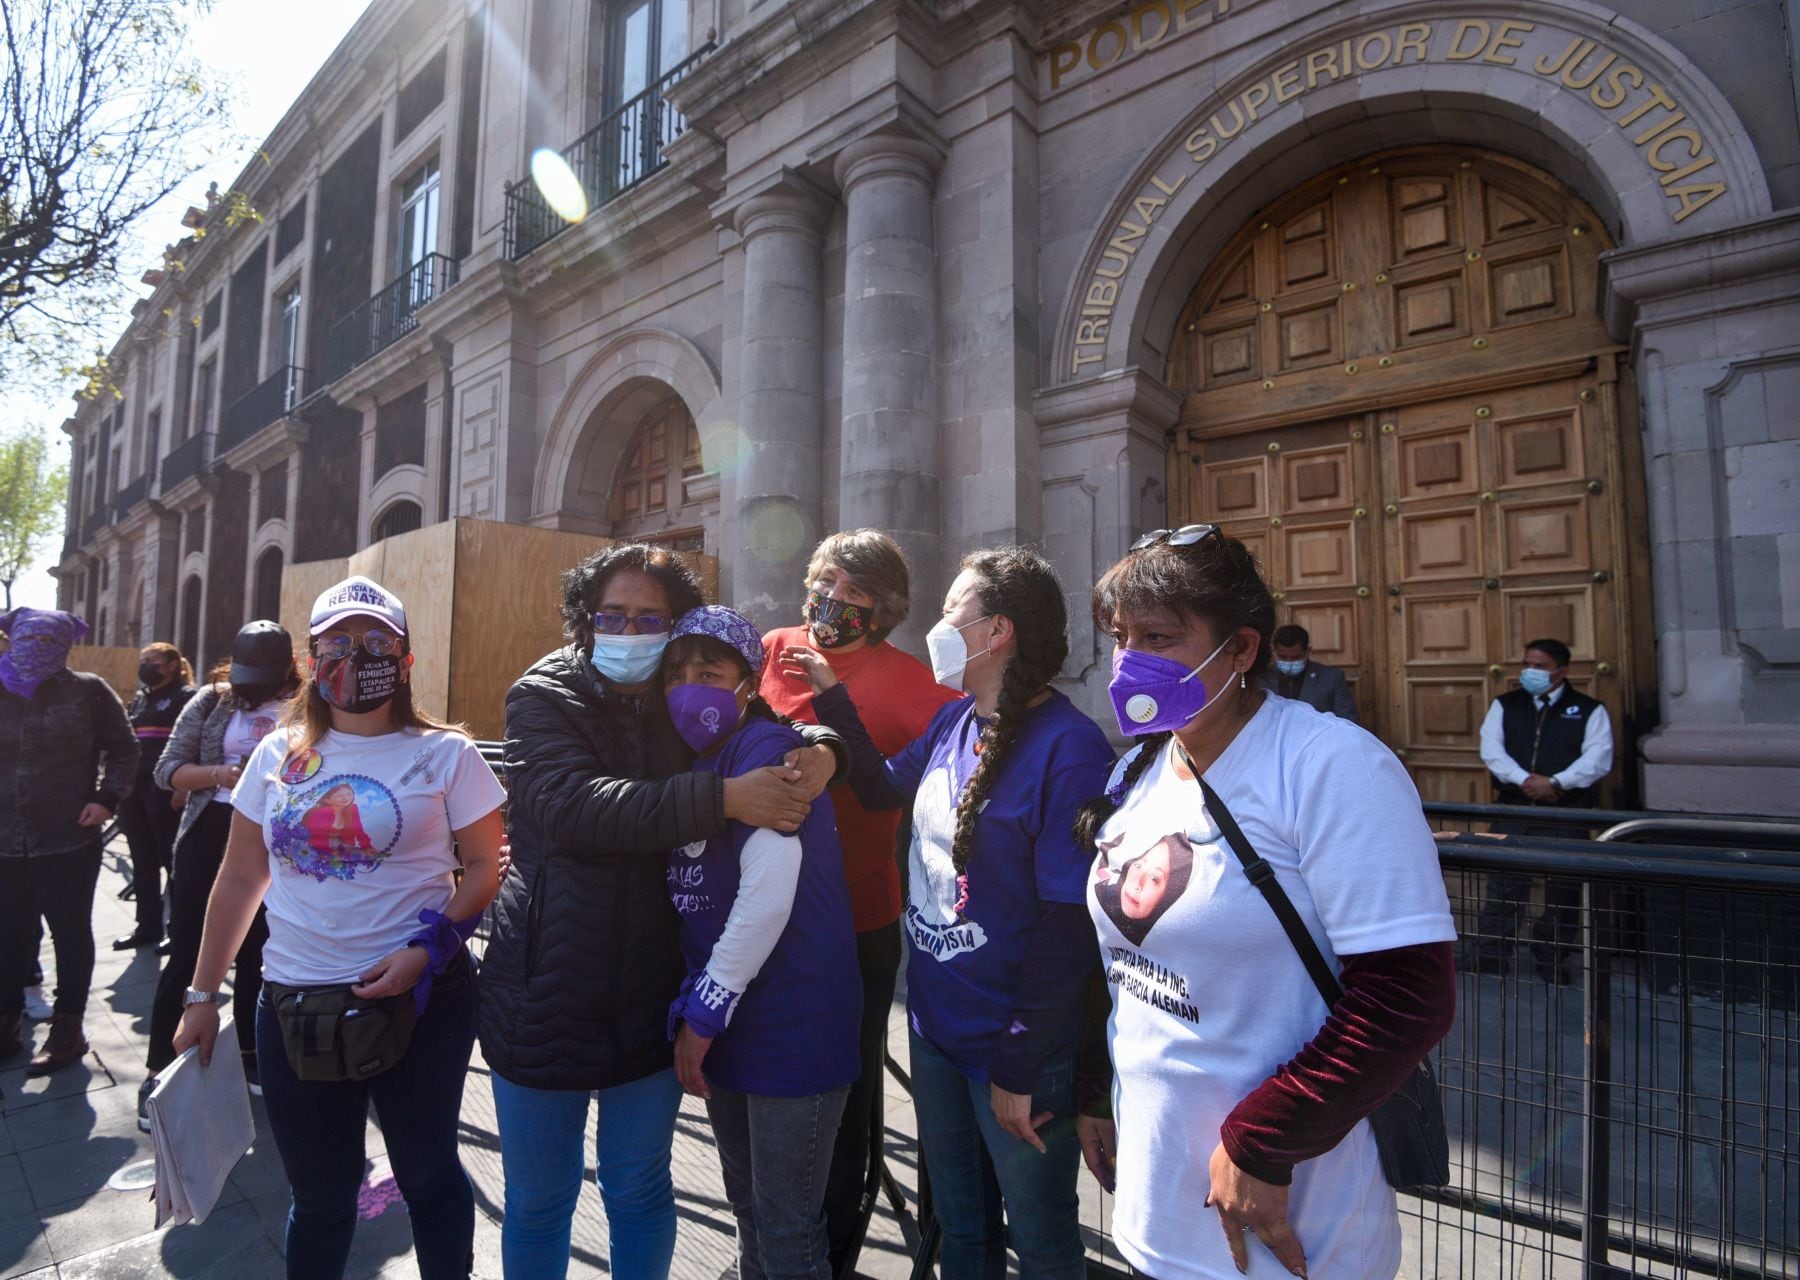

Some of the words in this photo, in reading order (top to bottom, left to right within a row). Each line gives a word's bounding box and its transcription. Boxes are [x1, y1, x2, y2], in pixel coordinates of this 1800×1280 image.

[1050, 0, 1230, 91] PODE
[1072, 173, 1187, 375] TRIBUNAL
[1184, 22, 1432, 163] SUPERIOR
[1446, 18, 1535, 66] DE
[1535, 36, 1727, 224] JUSTICIA
[329, 592, 386, 608] RENATA
[369, 587, 387, 600] PARA
[1107, 946, 1137, 970] JUSTICIA
[1136, 954, 1155, 981] PARA
[1156, 963, 1168, 988] LA
[1169, 971, 1190, 1000] ING.
[1126, 974, 1149, 1005] GARCIA
[1151, 988, 1199, 1025] ALEMAN
